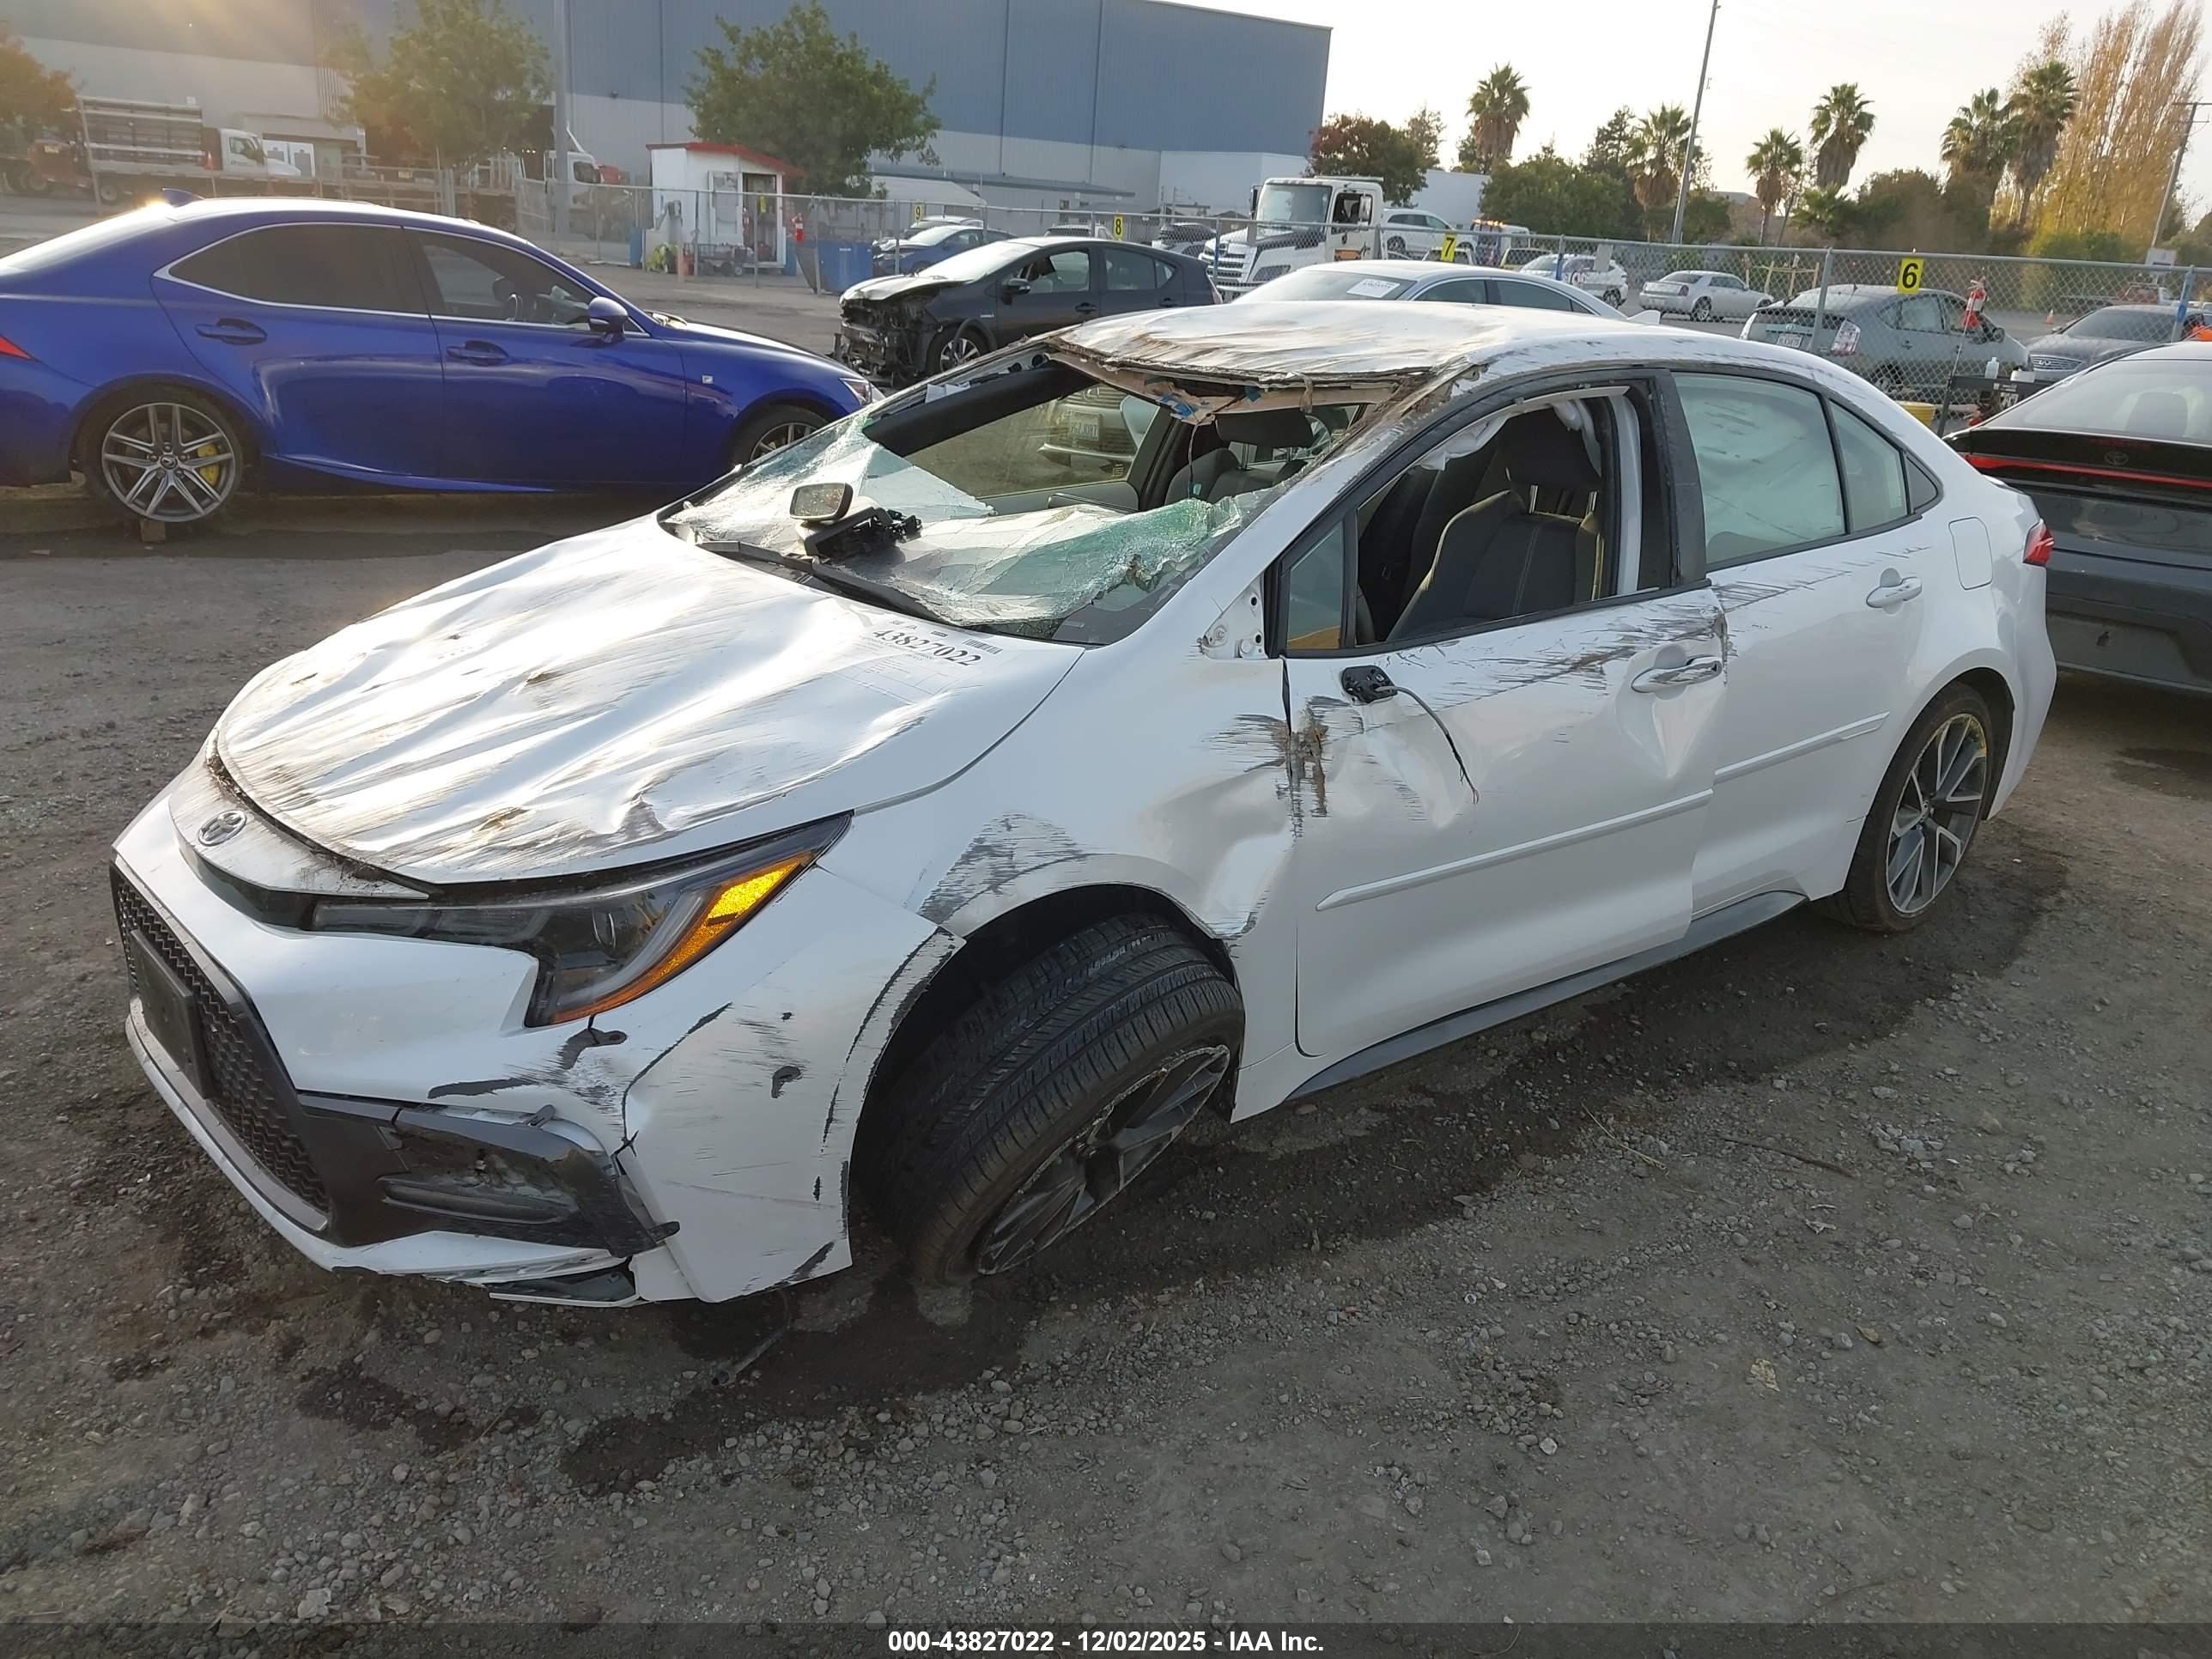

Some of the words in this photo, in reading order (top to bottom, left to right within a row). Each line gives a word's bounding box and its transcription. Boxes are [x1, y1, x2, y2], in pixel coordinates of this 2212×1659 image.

[915, 205, 921, 221] 9
[1115, 218, 1121, 235] 8
[1445, 236, 1455, 258] 7
[1902, 262, 1919, 289] 6
[872, 630, 981, 665] 43827022
